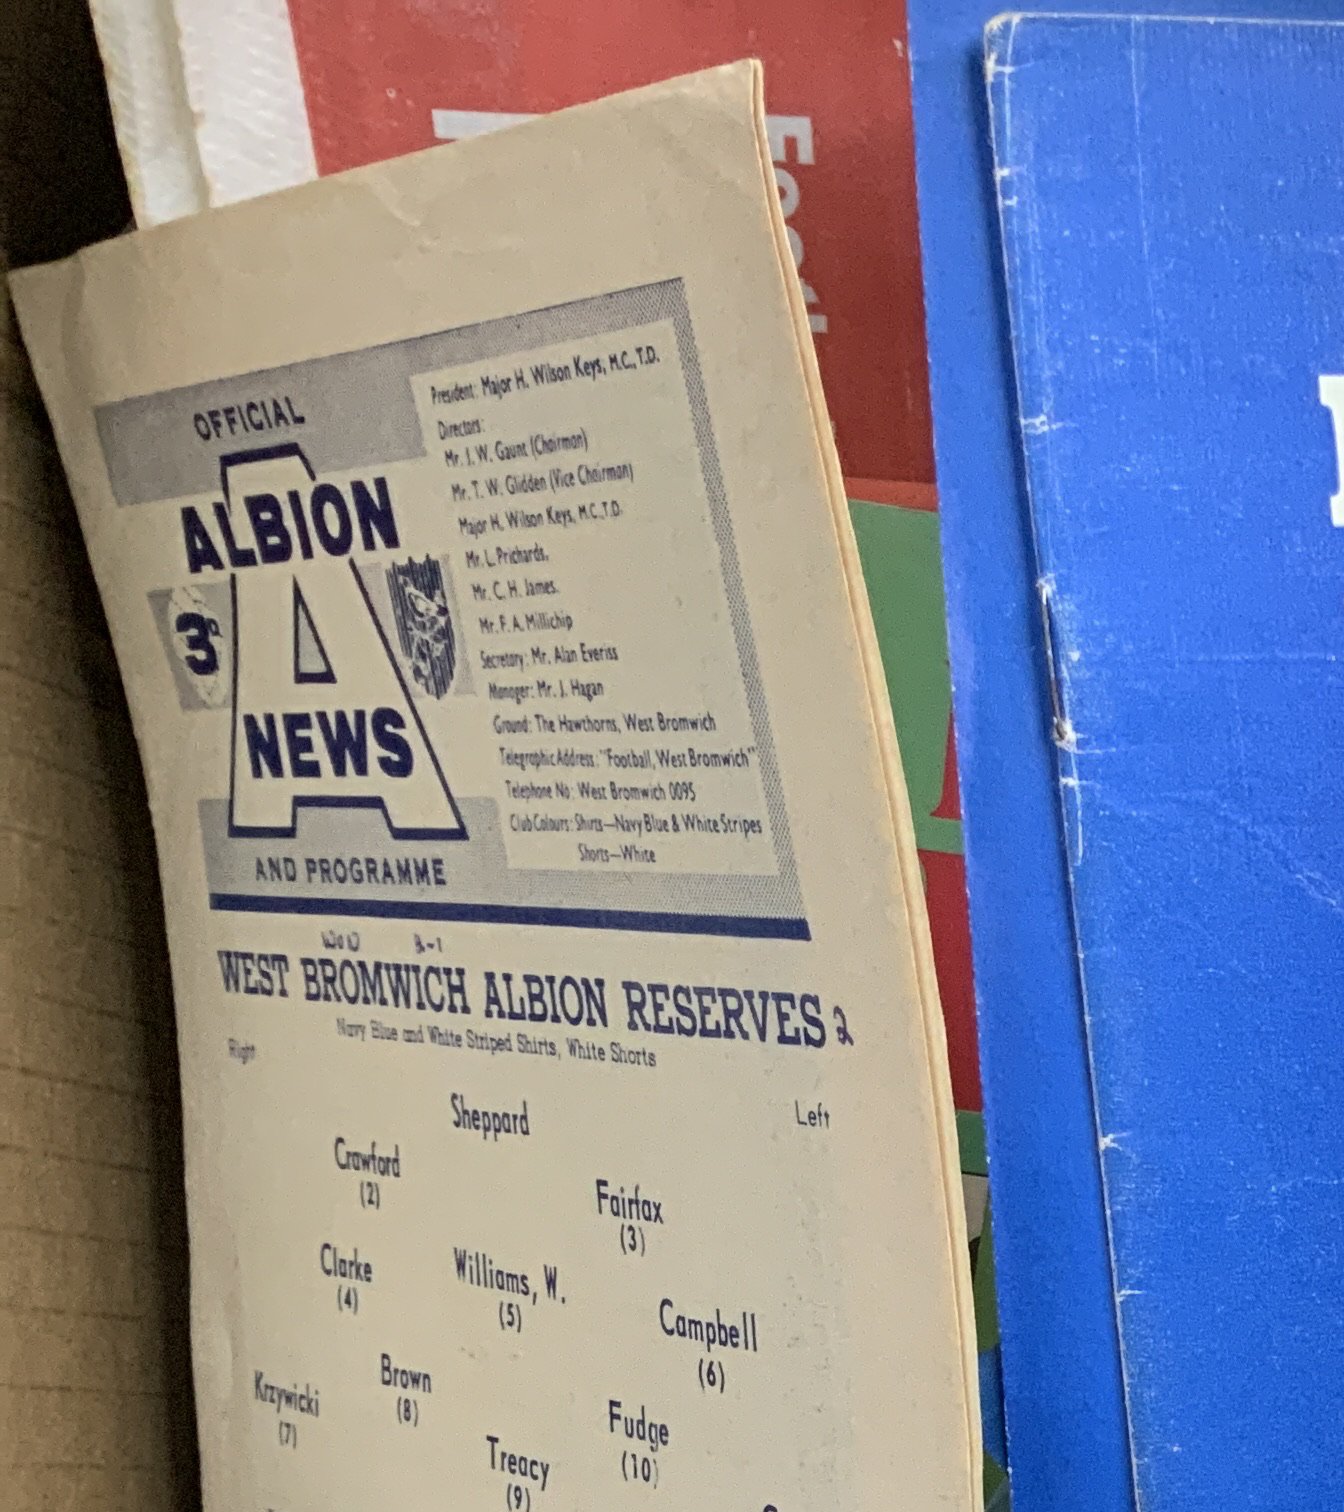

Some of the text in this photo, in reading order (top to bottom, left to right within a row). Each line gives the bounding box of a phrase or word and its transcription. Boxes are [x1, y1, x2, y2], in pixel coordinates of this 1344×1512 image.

[194, 395, 305, 441] OFFICIAL
[181, 477, 400, 573] ALBION
[243, 706, 414, 778] NEWS
[255, 856, 447, 886] AND PROGRAMME
[217, 950, 828, 1048] WEST BROMWICH ALBION RESERVES
[450, 1092, 531, 1141] Sheppard
[795, 1099, 829, 1128] Left
[333, 1136, 401, 1178] Crawford
[596, 1178, 665, 1225] Fairfax
[319, 1243, 373, 1283] Clarke
[620, 1224, 646, 1257] (3)
[453, 1247, 567, 1305] Williams, W.
[659, 1299, 758, 1352] Campbell
[380, 1353, 432, 1395] Brown
[697, 1360, 726, 1393] (6)
[608, 1400, 670, 1451] Fudge
[485, 1435, 551, 1489] Treacy
[621, 1451, 660, 1489] (10)
